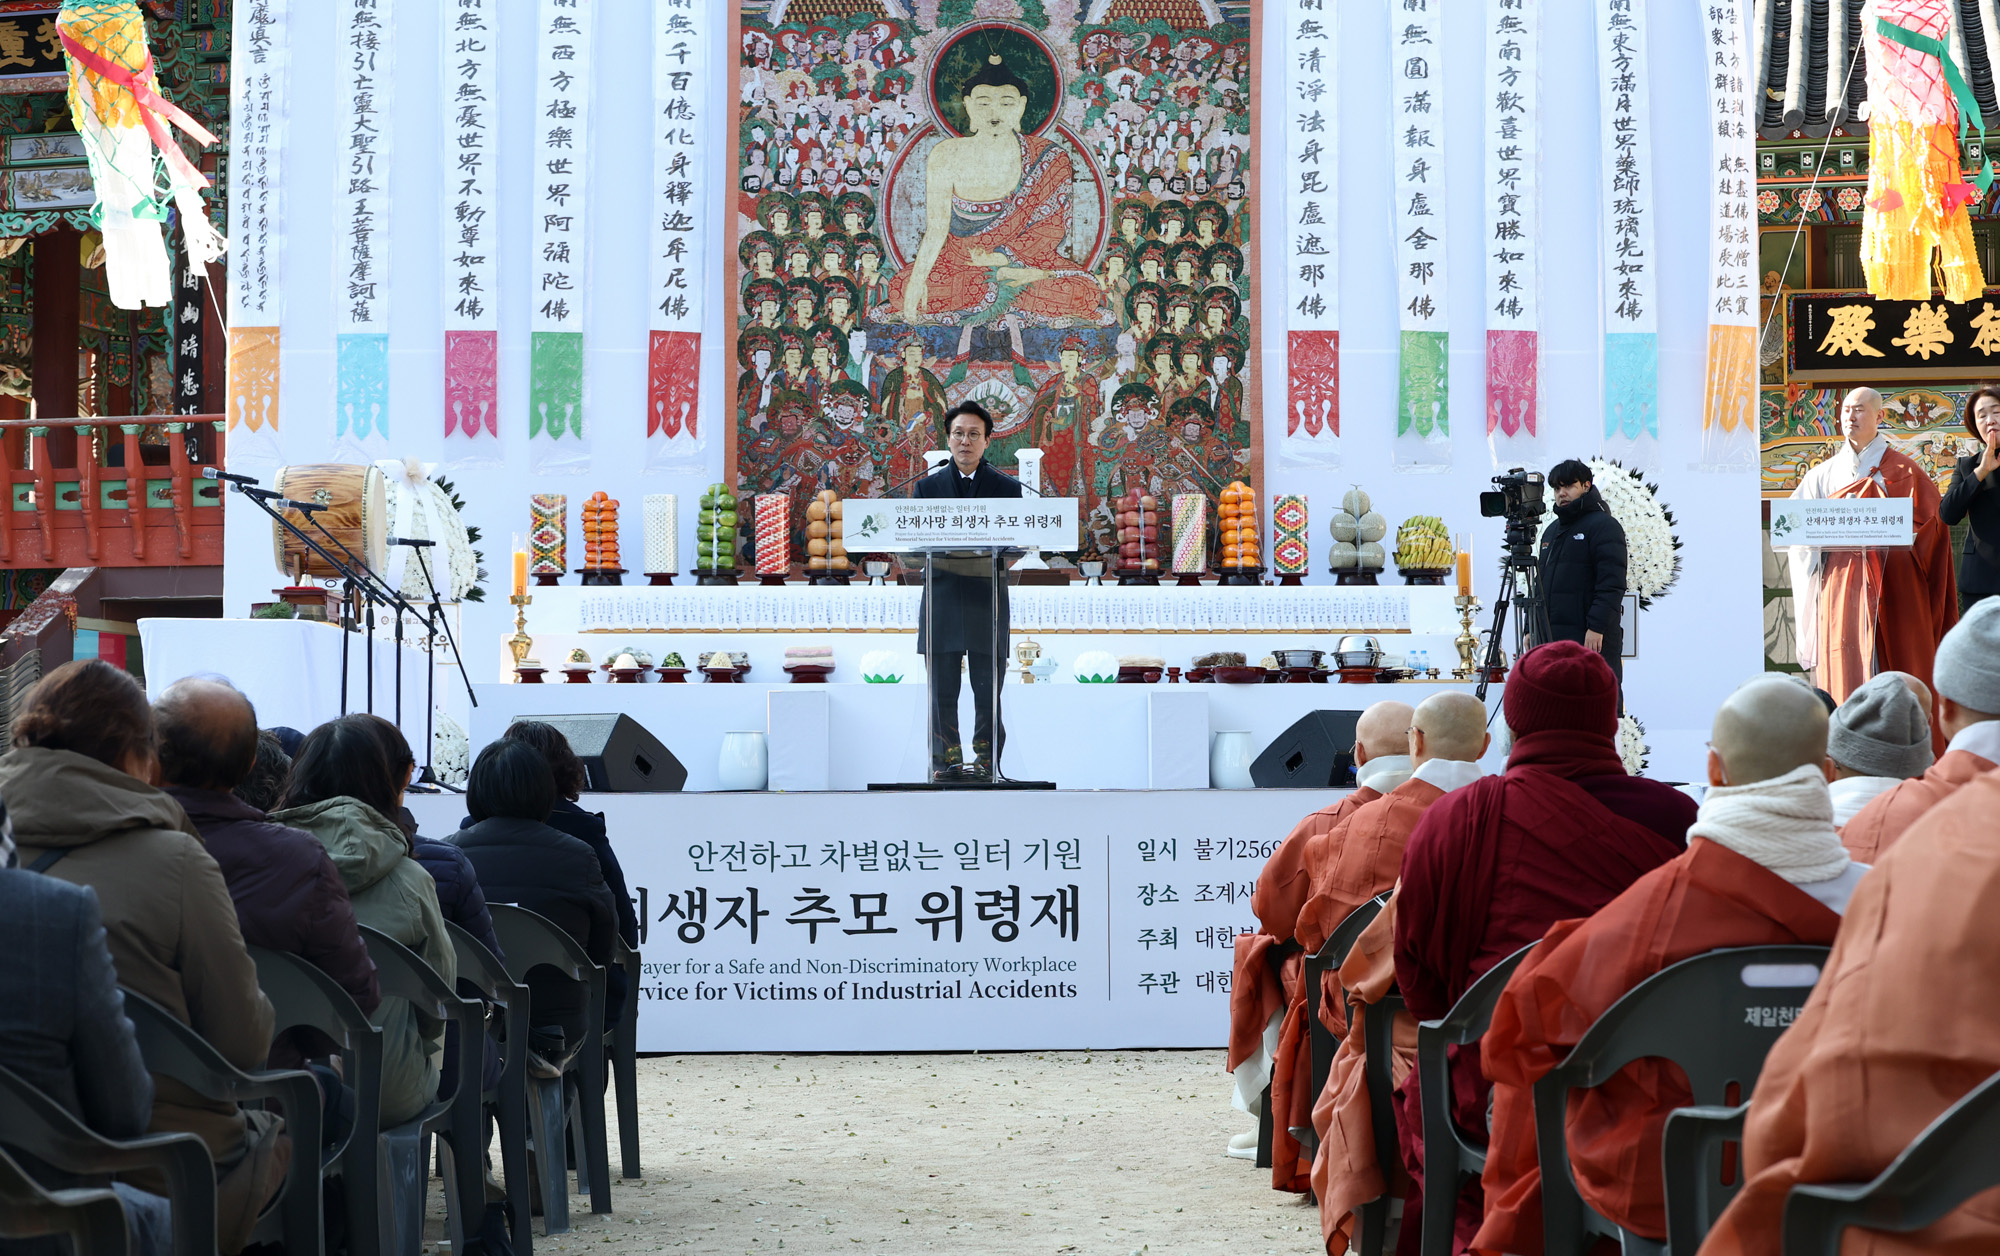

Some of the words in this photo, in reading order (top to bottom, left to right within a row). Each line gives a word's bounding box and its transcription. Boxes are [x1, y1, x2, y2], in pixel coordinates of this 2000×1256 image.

[895, 504, 924, 514] 안전하고
[926, 504, 954, 514] 차별없는
[956, 504, 971, 514] 일터
[972, 504, 987, 514] 기원
[1805, 516, 1836, 526] 산재사망
[1838, 516, 1862, 526] 희생자
[1863, 515, 1879, 525] 추모
[1880, 515, 1904, 525] 위령재
[895, 514, 947, 530] 산재사망
[951, 514, 990, 530] 희생자
[994, 514, 1020, 529] 추모
[1023, 514, 1062, 529] 위령재
[688, 840, 811, 873] 안전하고
[820, 840, 943, 873] 차별없는
[953, 838, 1010, 872] 일터
[1023, 837, 1082, 871] 기원
[1137, 838, 1177, 862] 일시
[1137, 883, 1180, 906] 장소
[1194, 881, 1255, 905] 조계사
[785, 887, 898, 944] 추모
[914, 884, 1080, 943] 위령재
[1137, 926, 1178, 950] 주최
[641, 962, 681, 979] ayer
[685, 958, 710, 974] for
[715, 962, 725, 974] a
[729, 958, 764, 974] Safe
[769, 957, 801, 974] and
[806, 957, 979, 977] Non-Discriminatory
[983, 956, 1077, 976] Workplace
[695, 981, 727, 1000] for
[733, 981, 817, 1000] Victims
[824, 980, 848, 1000] of
[852, 980, 962, 1000] Industrial
[968, 978, 1078, 999] Accidents
[1138, 971, 1181, 995] 주관
